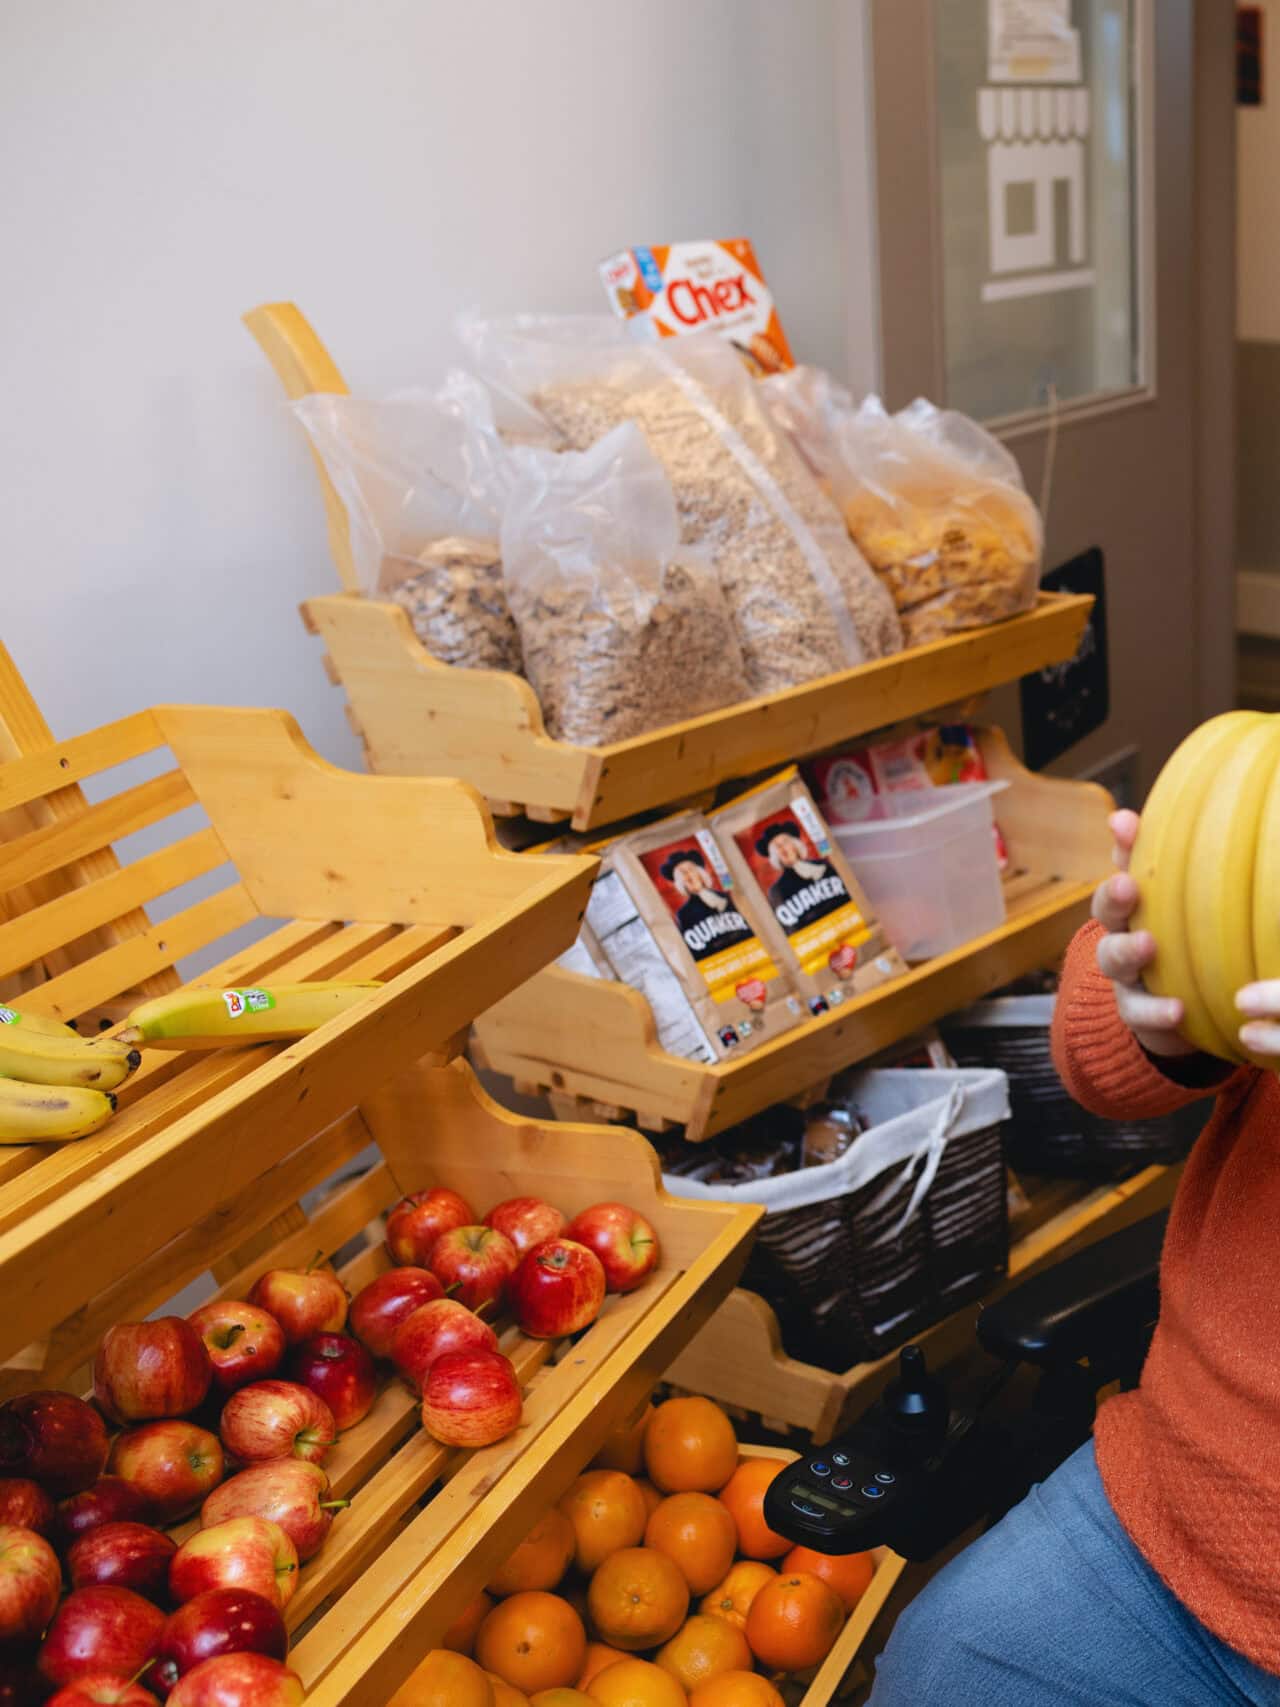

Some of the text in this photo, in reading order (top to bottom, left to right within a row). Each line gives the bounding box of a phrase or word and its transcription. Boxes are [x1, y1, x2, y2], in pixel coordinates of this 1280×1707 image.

[666, 273, 757, 326] Chex
[776, 875, 846, 926] QUAKER
[684, 912, 746, 951] QUAKER
